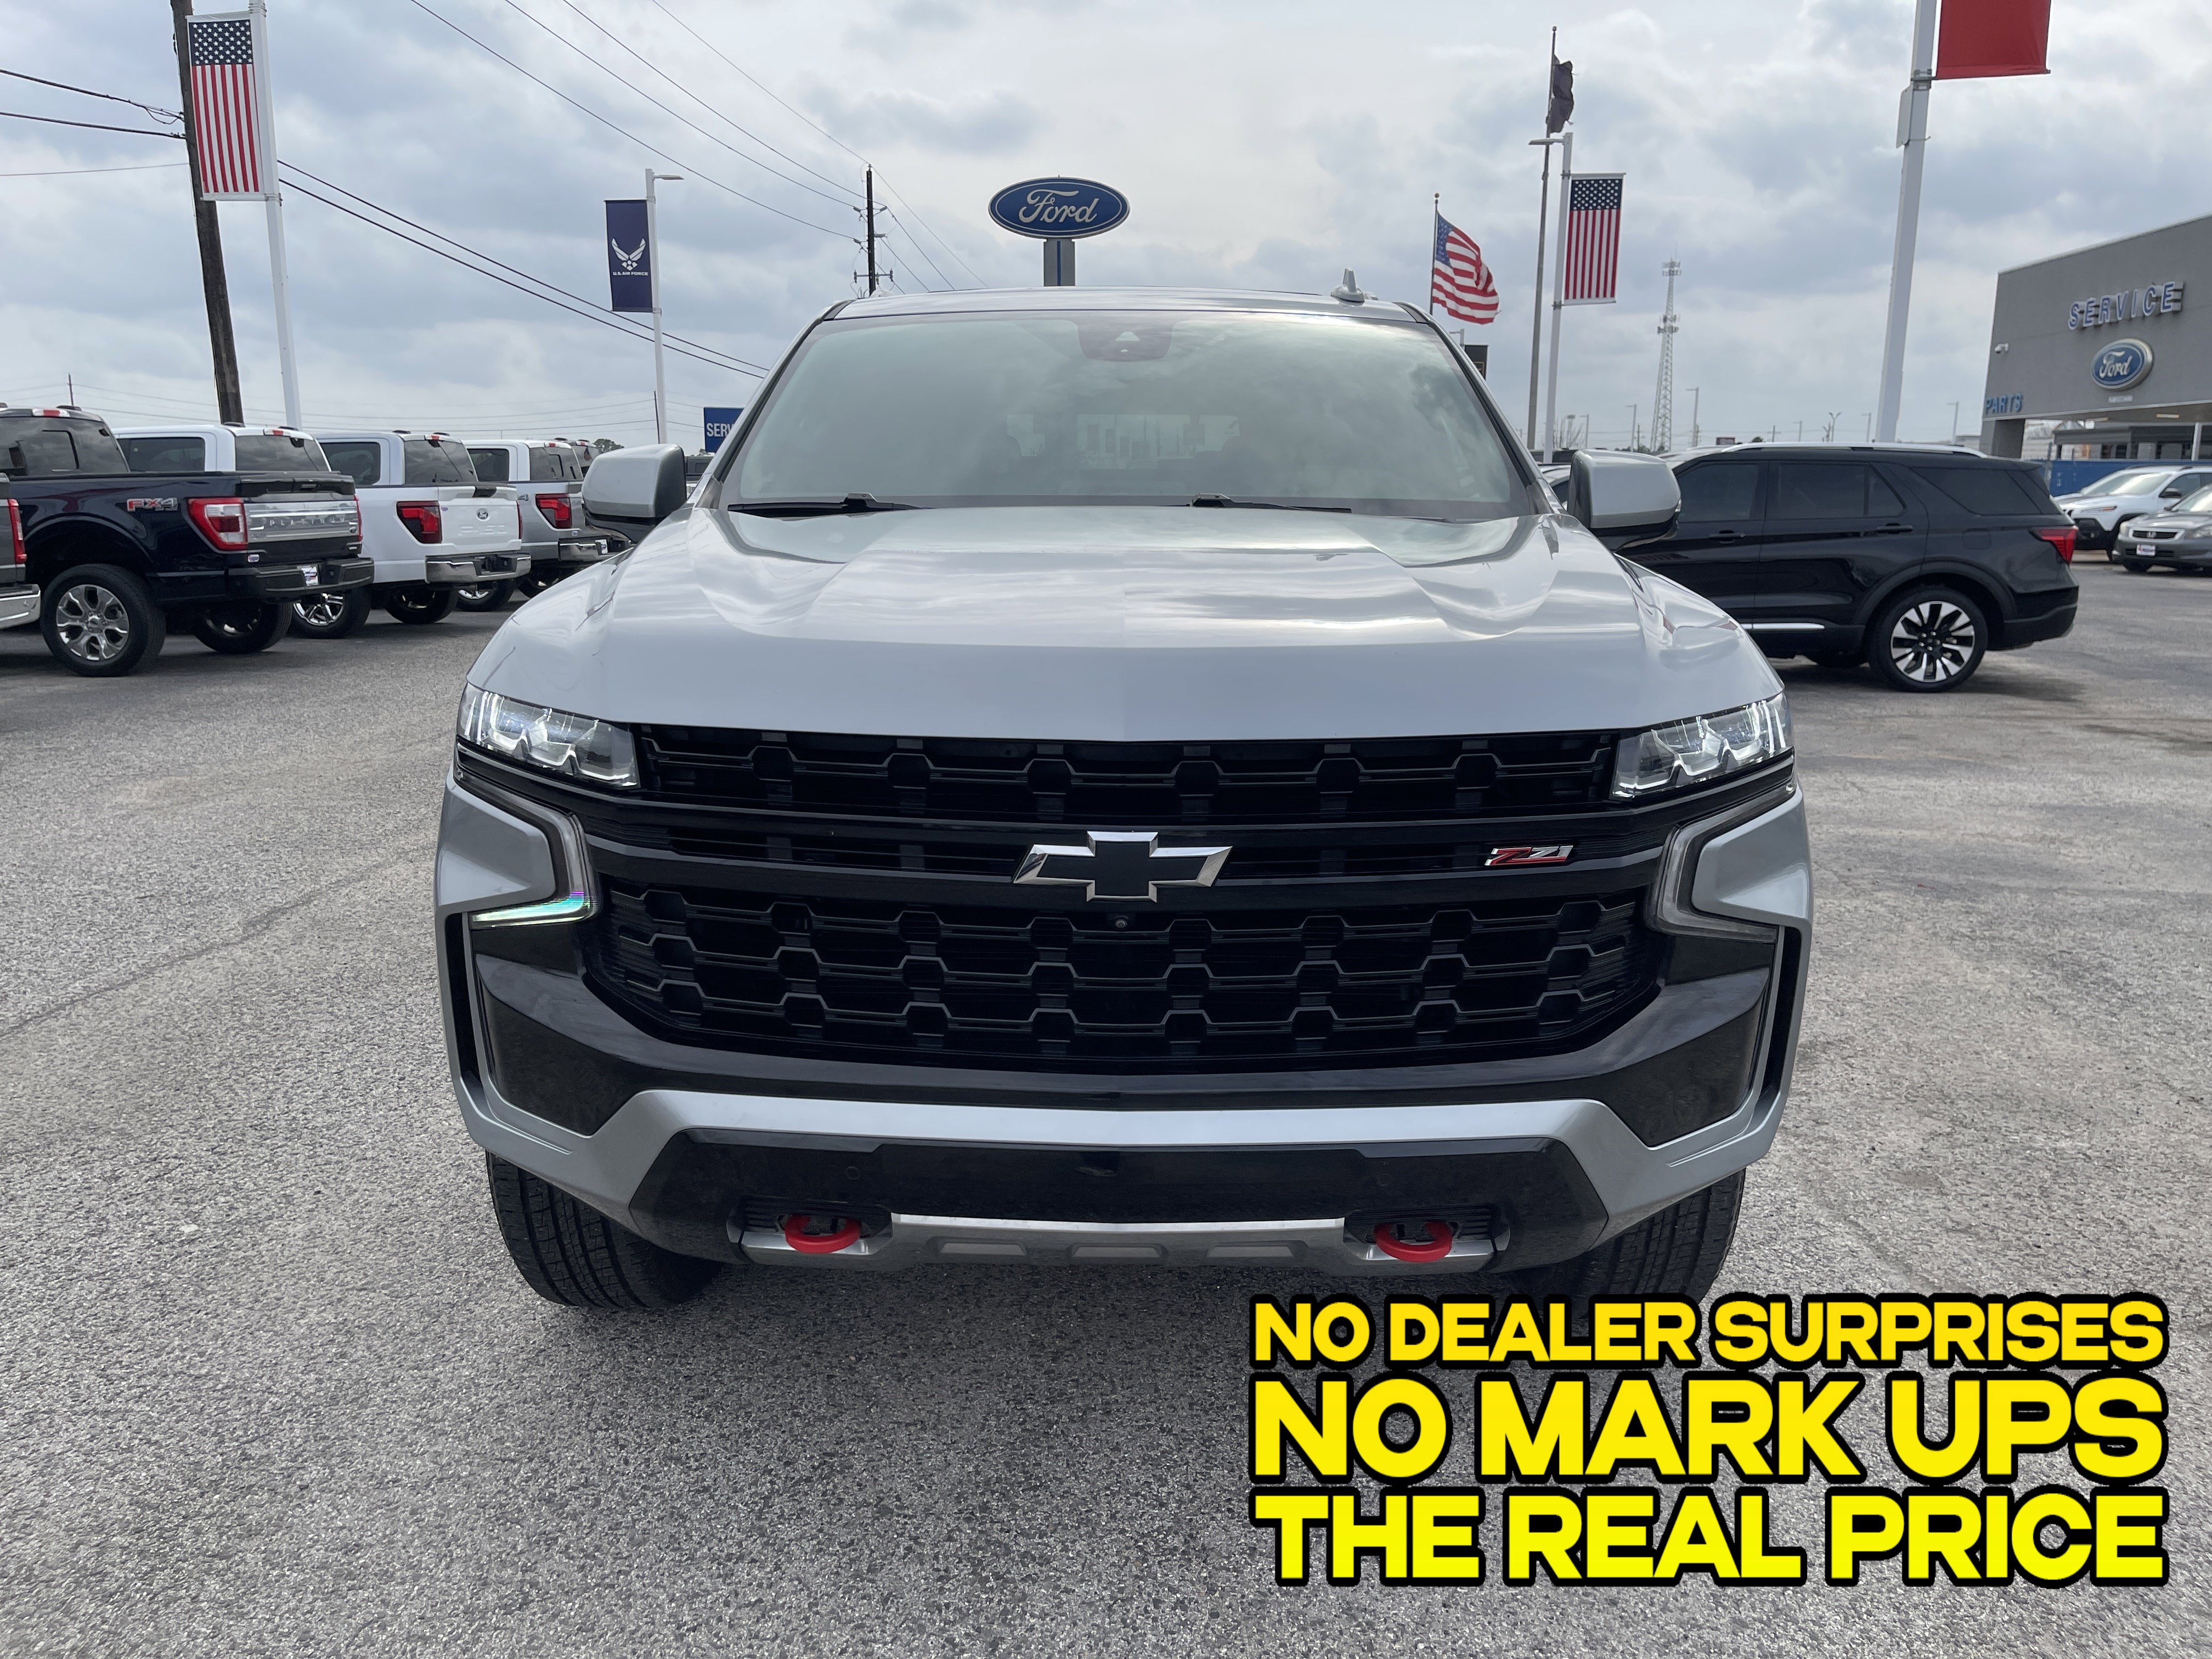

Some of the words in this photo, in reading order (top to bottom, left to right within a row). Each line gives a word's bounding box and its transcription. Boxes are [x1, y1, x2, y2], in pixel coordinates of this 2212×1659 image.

[1018, 189, 1100, 223] Ford
[2068, 281, 2178, 330] SERVICE
[2099, 350, 2132, 379] Ford
[1985, 392, 2023, 415] PARTS
[127, 497, 178, 512] FX4
[1484, 845, 1574, 866] Z71
